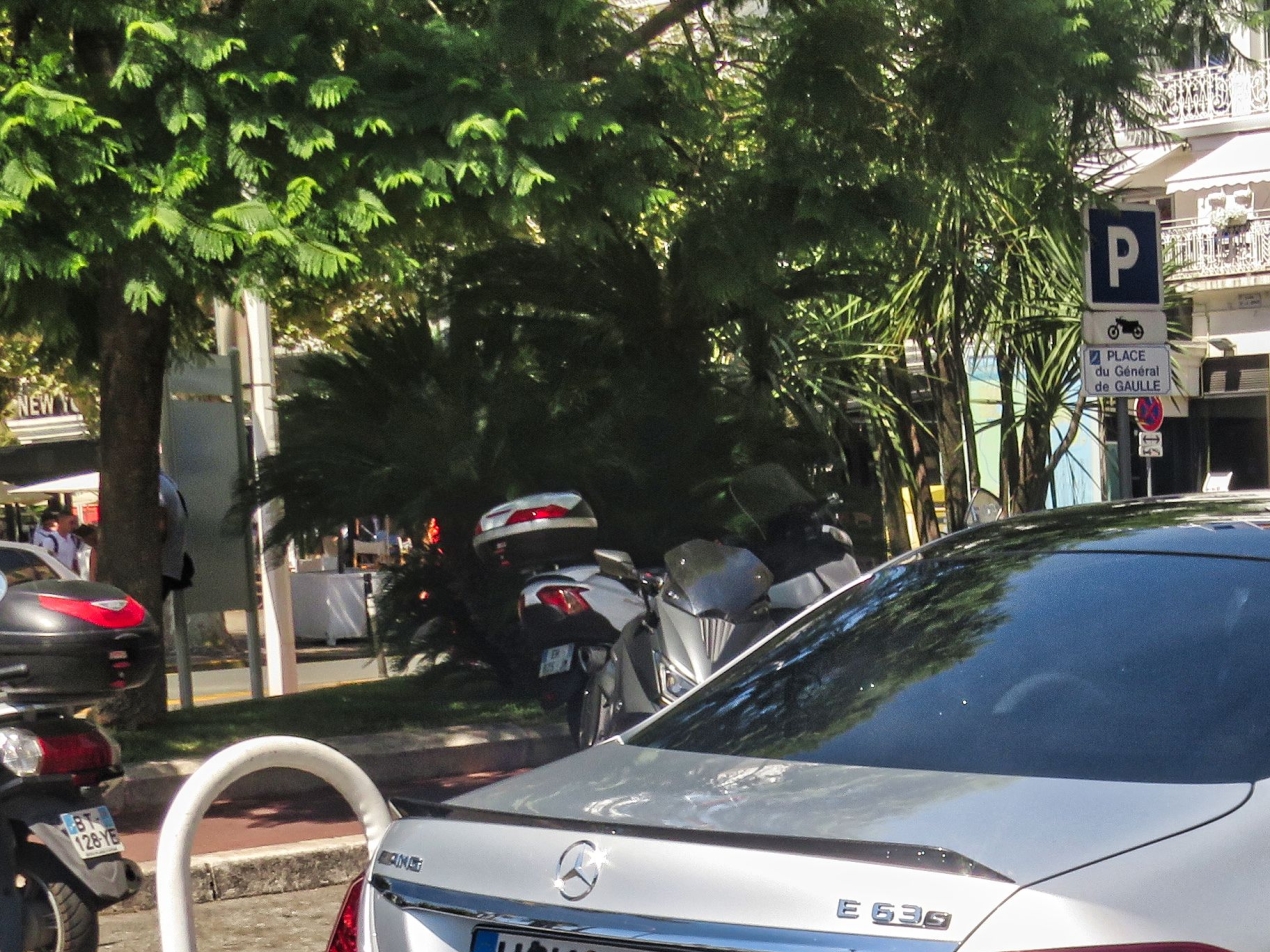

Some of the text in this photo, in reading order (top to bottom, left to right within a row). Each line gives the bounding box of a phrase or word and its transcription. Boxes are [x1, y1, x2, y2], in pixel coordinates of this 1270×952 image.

[1107, 226, 1140, 287] P
[1107, 350, 1146, 361] PLACE
[1095, 365, 1159, 377] du Général
[1095, 380, 1161, 392] de GAULLE
[18, 393, 54, 417] NEW
[75, 828, 119, 852] 128-YE
[836, 898, 861, 919] E
